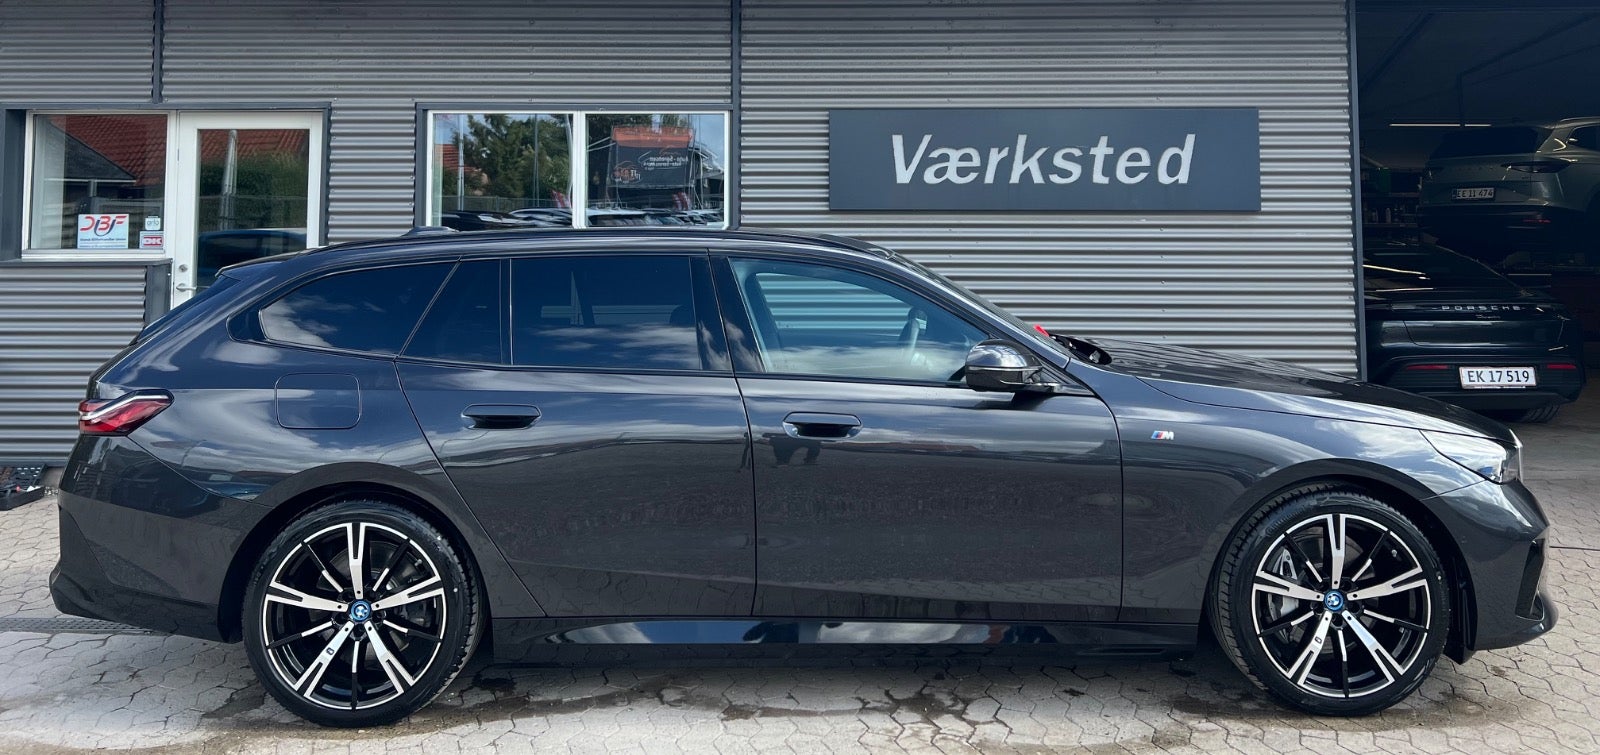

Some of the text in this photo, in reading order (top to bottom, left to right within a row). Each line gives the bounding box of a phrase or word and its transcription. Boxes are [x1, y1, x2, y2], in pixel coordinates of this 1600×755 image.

[892, 133, 1195, 184] Værksted
[1467, 370, 1530, 383] EK 17 519
